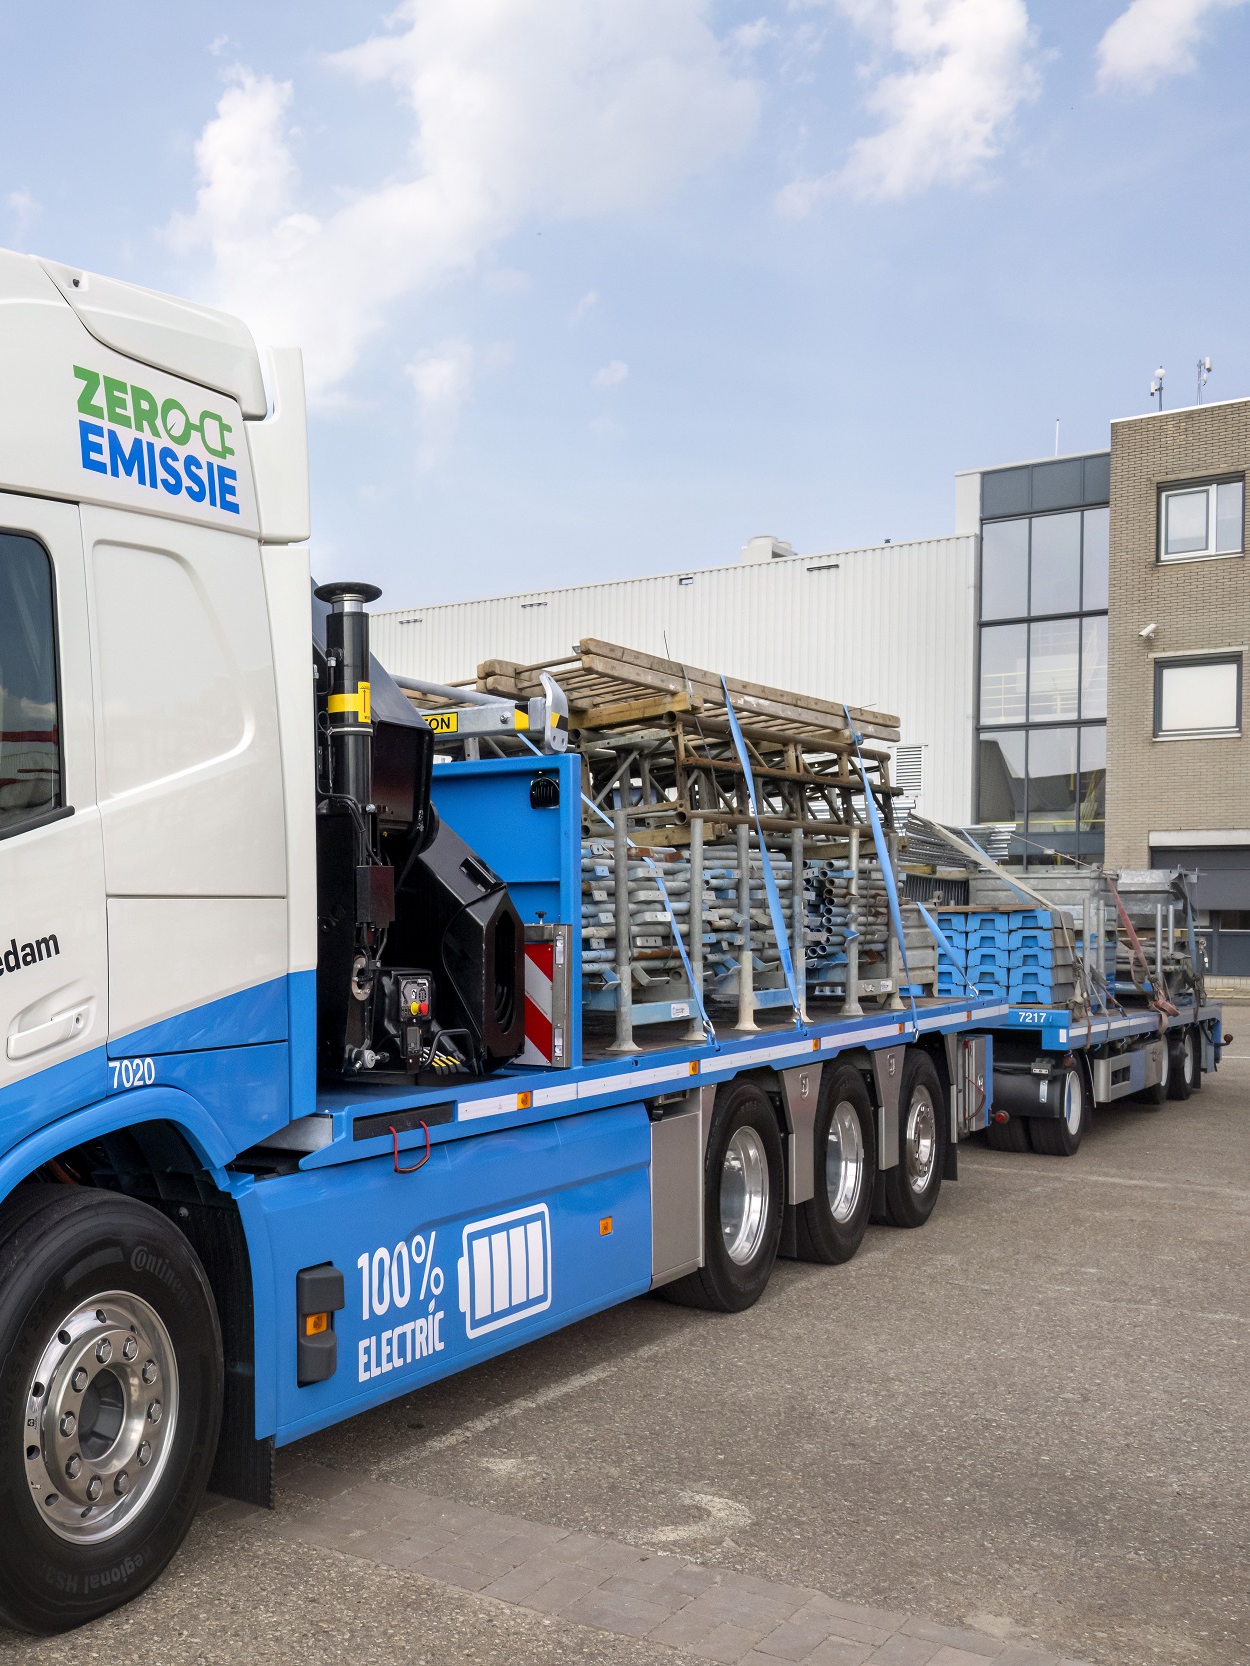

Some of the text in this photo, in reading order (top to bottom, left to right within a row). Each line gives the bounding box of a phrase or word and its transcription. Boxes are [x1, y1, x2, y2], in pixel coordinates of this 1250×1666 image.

[72, 364, 192, 447] ZERO
[78, 418, 241, 515] EMISSIE
[425, 716, 450, 730] ON
[1018, 1012, 1047, 1023] 7217
[108, 1057, 156, 1088] 7020
[357, 1230, 445, 1321] 100%
[358, 1299, 444, 1383] ELECTRIC
